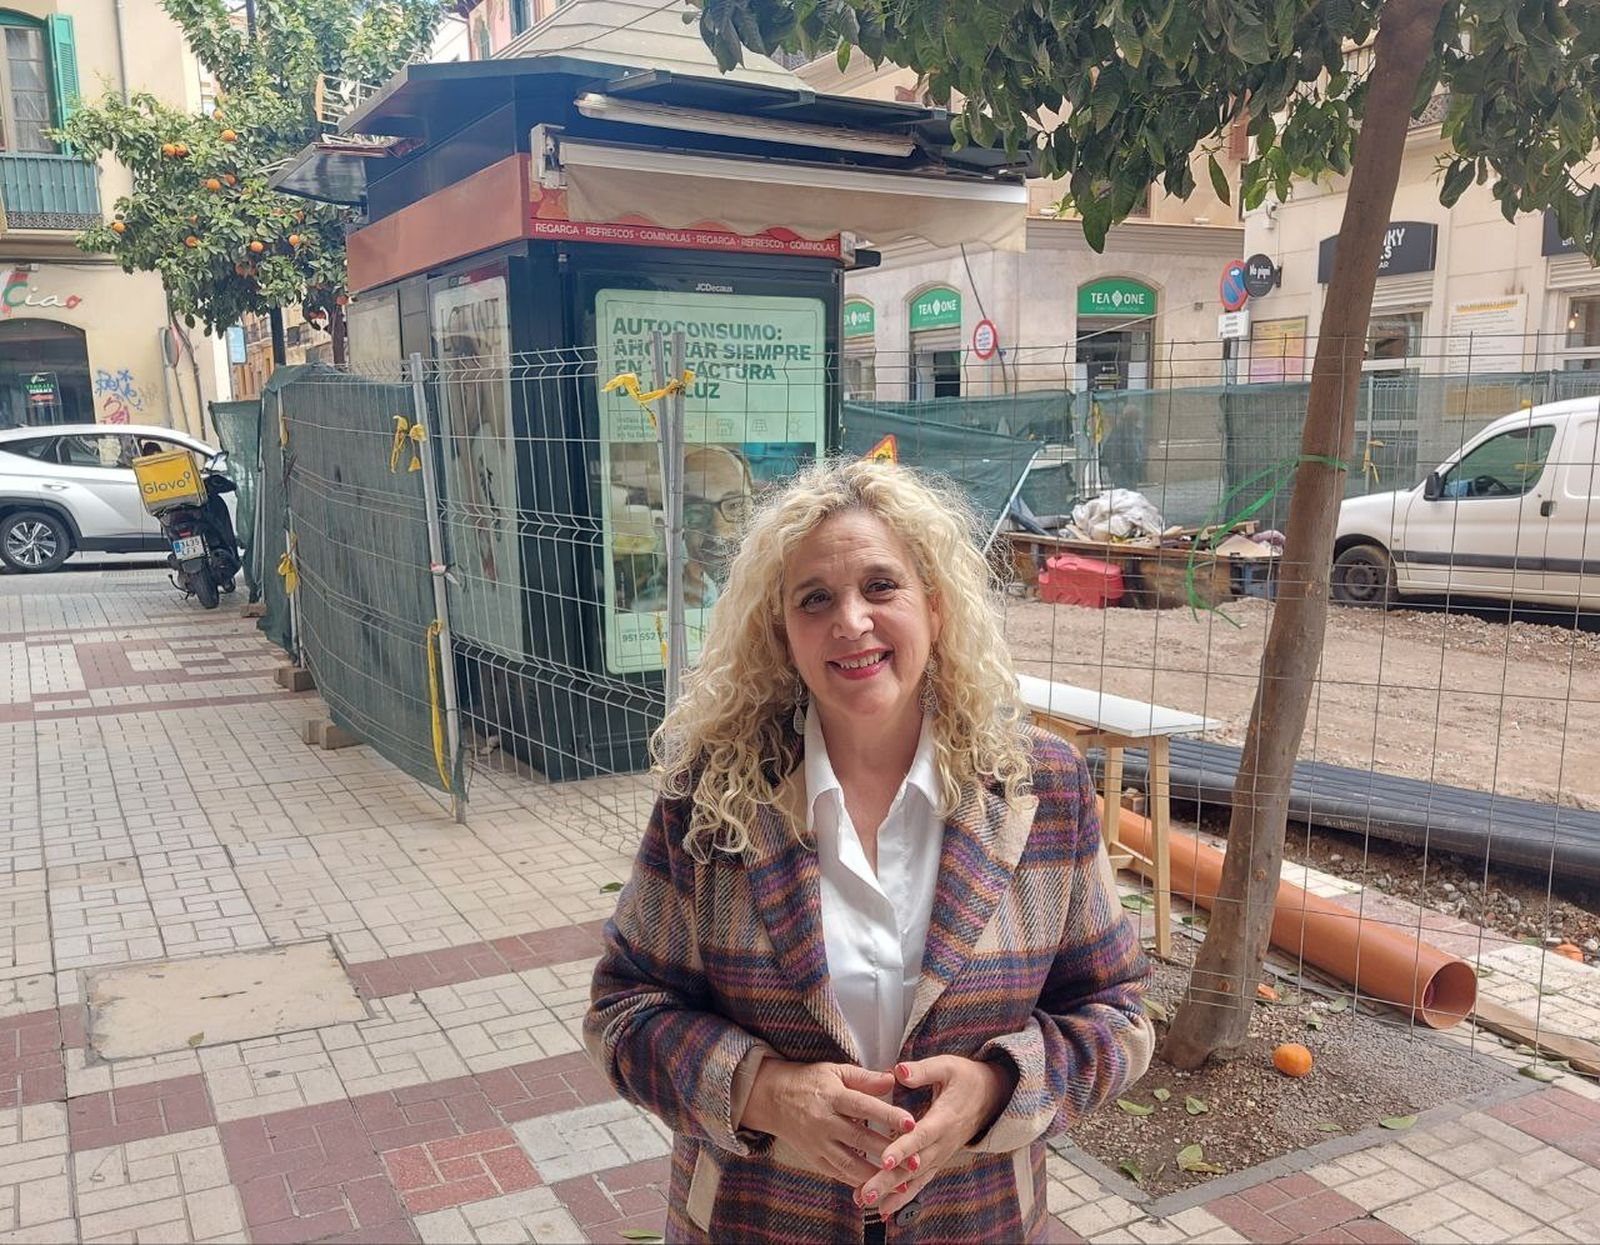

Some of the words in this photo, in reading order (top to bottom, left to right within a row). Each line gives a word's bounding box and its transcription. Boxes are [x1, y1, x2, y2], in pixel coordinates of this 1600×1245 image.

[585, 226, 634, 240] REFRESCOS
[639, 230, 691, 244] GOMINOLAS
[789, 240, 836, 252] GOMINOLAS
[3, 281, 81, 309] Ciao
[1090, 292, 1110, 304] TEA
[1123, 293, 1145, 305] ONE
[918, 303, 933, 316] TEA
[940, 299, 957, 312] ONE
[857, 311, 871, 323] ONE
[613, 317, 782, 341] AUTOCONSUMO:
[723, 343, 811, 361] SIEMPRE
[143, 479, 187, 495] Glovo
